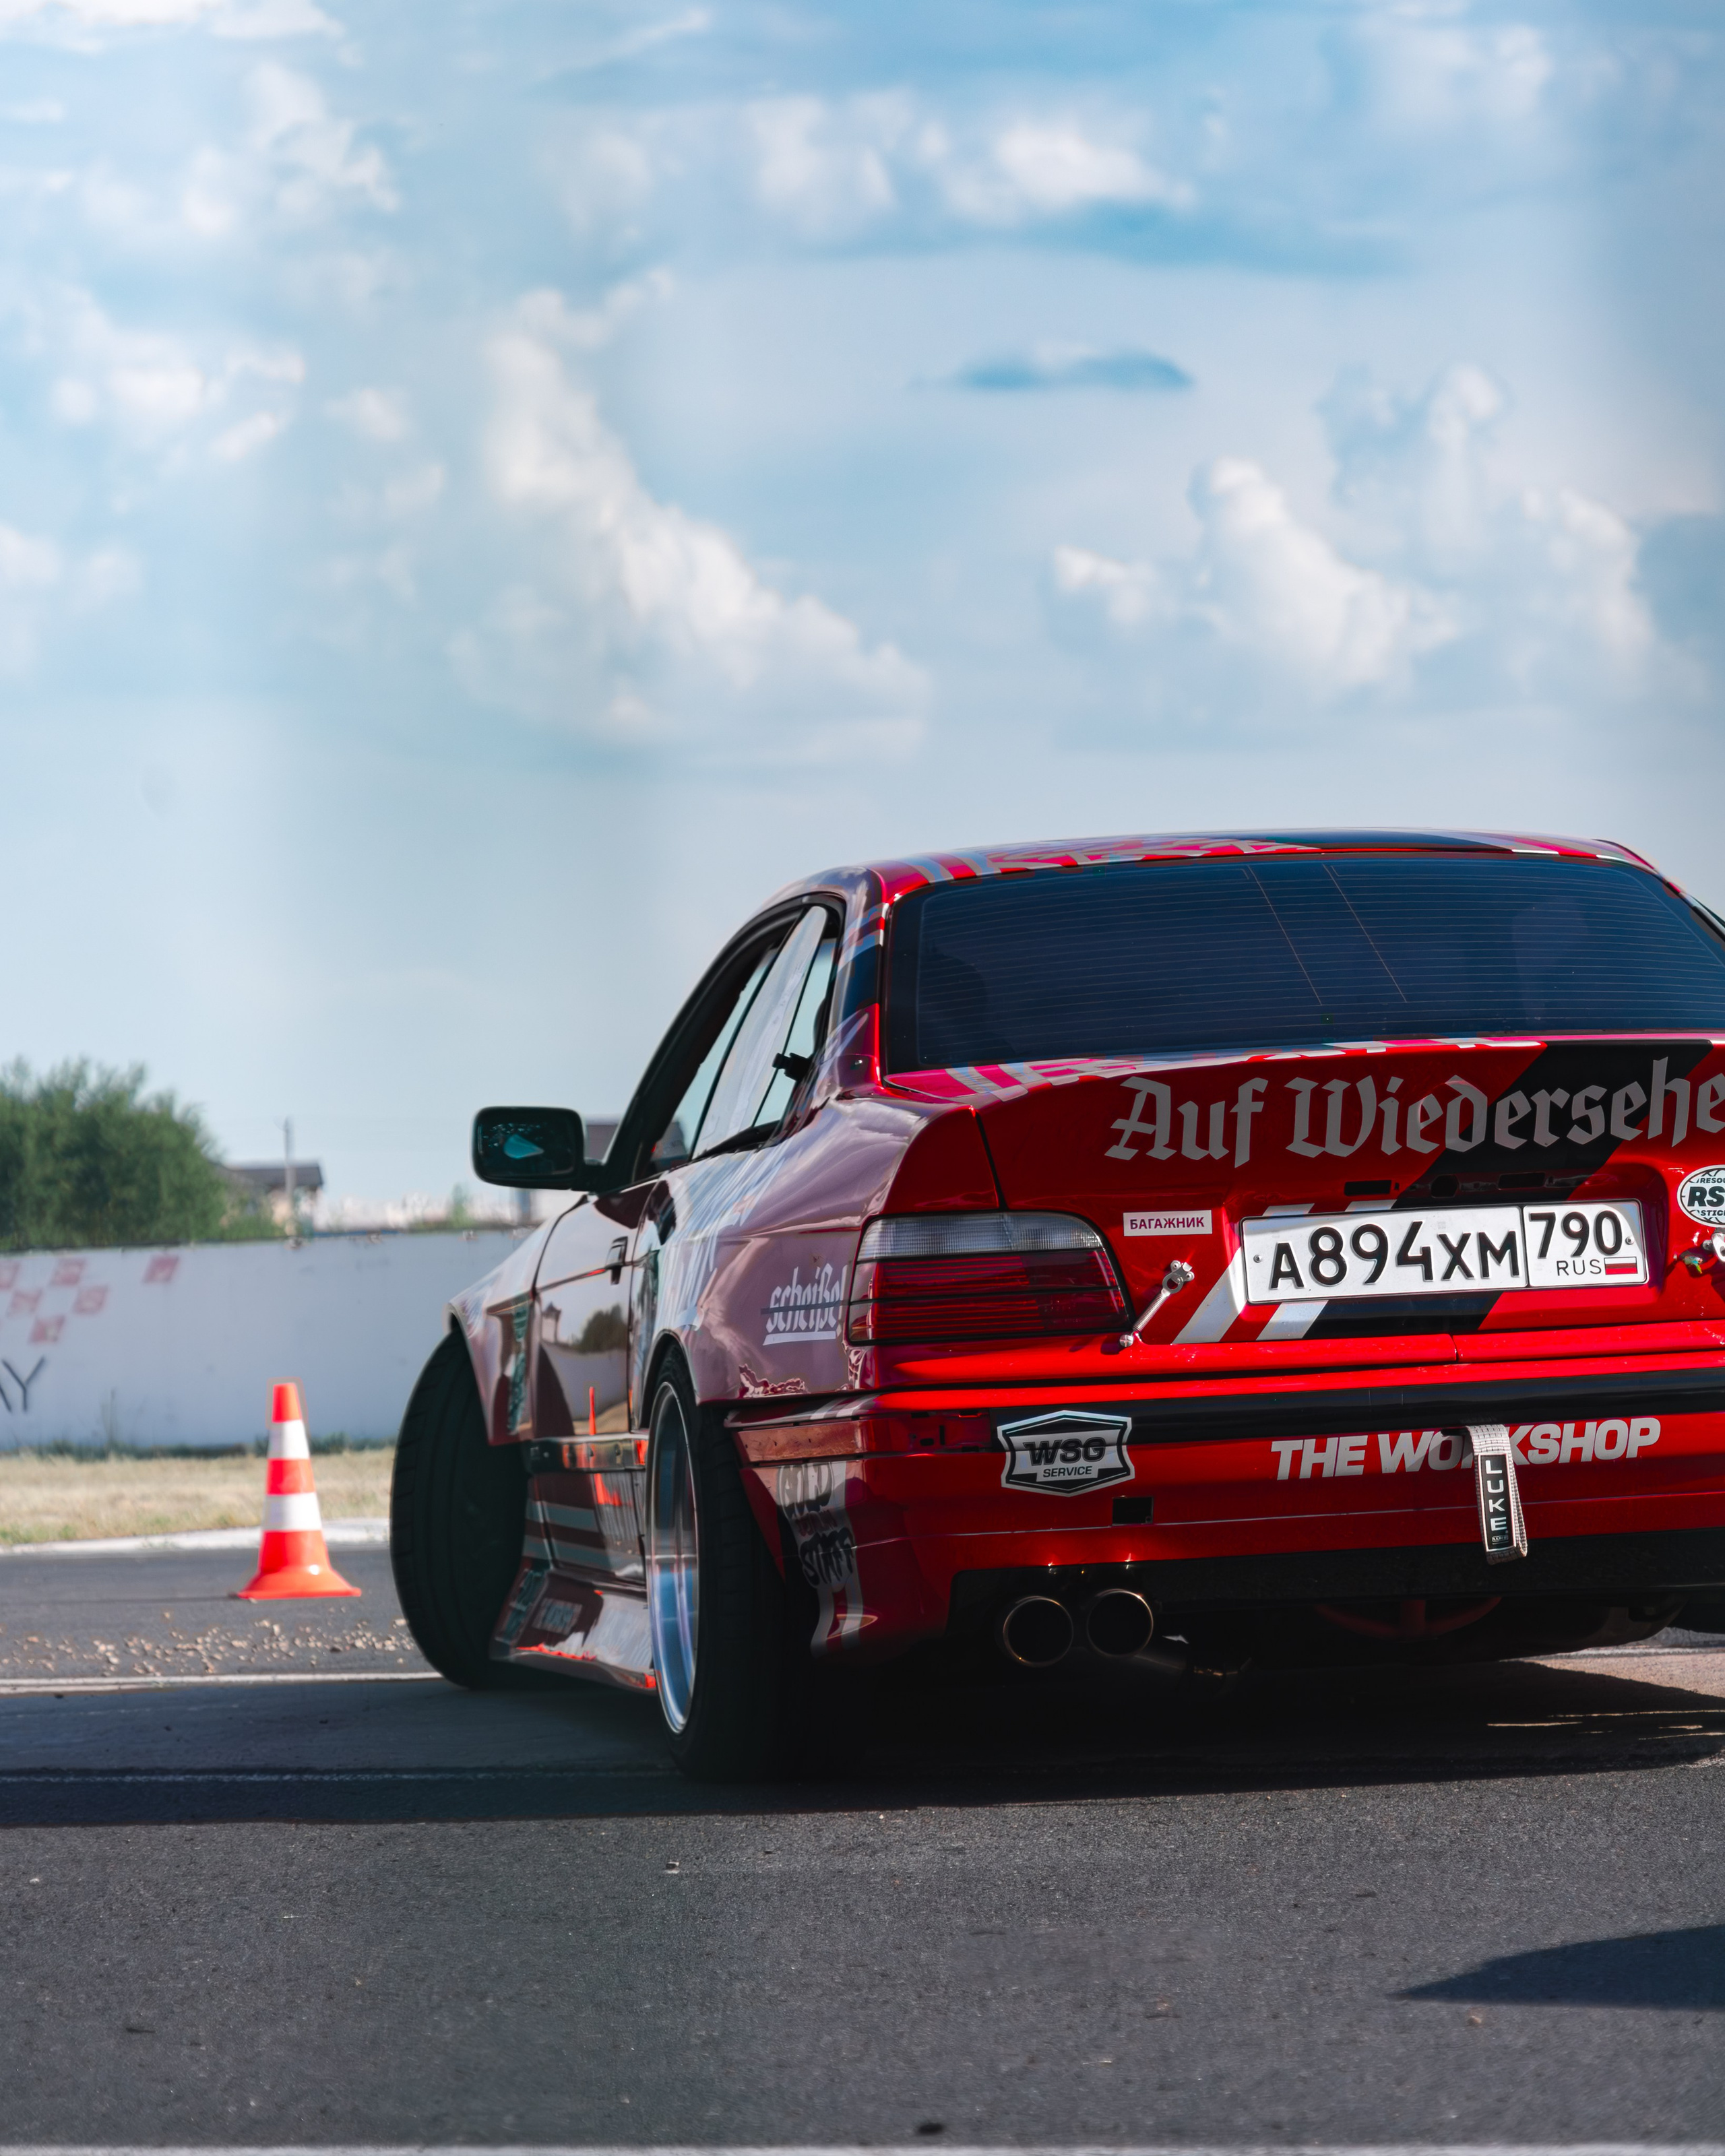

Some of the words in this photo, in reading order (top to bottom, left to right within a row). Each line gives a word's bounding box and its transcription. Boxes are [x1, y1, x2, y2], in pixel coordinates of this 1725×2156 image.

[1104, 1076, 1269, 1168] Auf
[1284, 1056, 1725, 1158] Wiedersehe
[1129, 1216, 1205, 1230] БАГАЖНИК
[1529, 1210, 1623, 1259] 790
[1557, 1259, 1602, 1277] RUS
[1023, 1436, 1106, 1466] WSG
[1272, 1434, 1368, 1481] THE
[1377, 1418, 1661, 1474] WOKSHOP
[1043, 1466, 1092, 1478] SERVICE
[1485, 1459, 1507, 1531] LUKE
